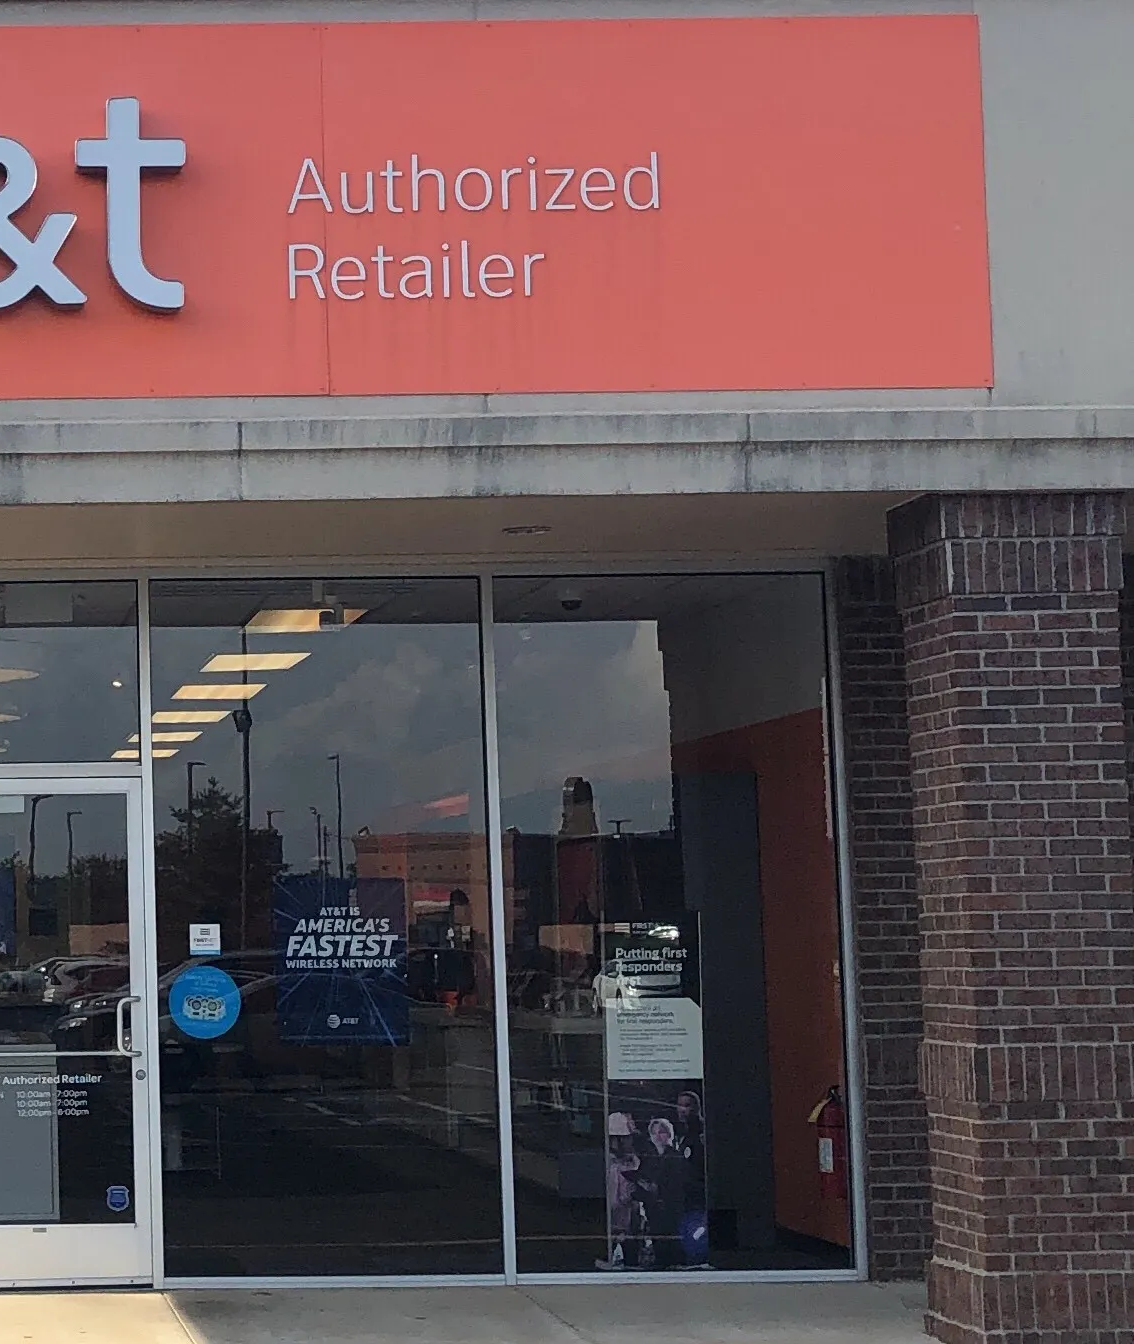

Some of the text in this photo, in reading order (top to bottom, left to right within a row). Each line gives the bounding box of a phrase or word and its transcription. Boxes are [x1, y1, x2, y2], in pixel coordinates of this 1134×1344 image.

[287, 151, 661, 215] Authorized
[287, 240, 545, 300] Retailer
[319, 906, 361, 916] AT&T IS
[293, 918, 390, 934] AMERICA'S
[286, 934, 399, 958] FASTEST
[615, 946, 688, 961] Putting first
[286, 958, 398, 969] WIRELESS NETWORK
[615, 961, 683, 974] responders
[2, 1074, 60, 1086] Authorized
[62, 1072, 102, 1084] Retailer
